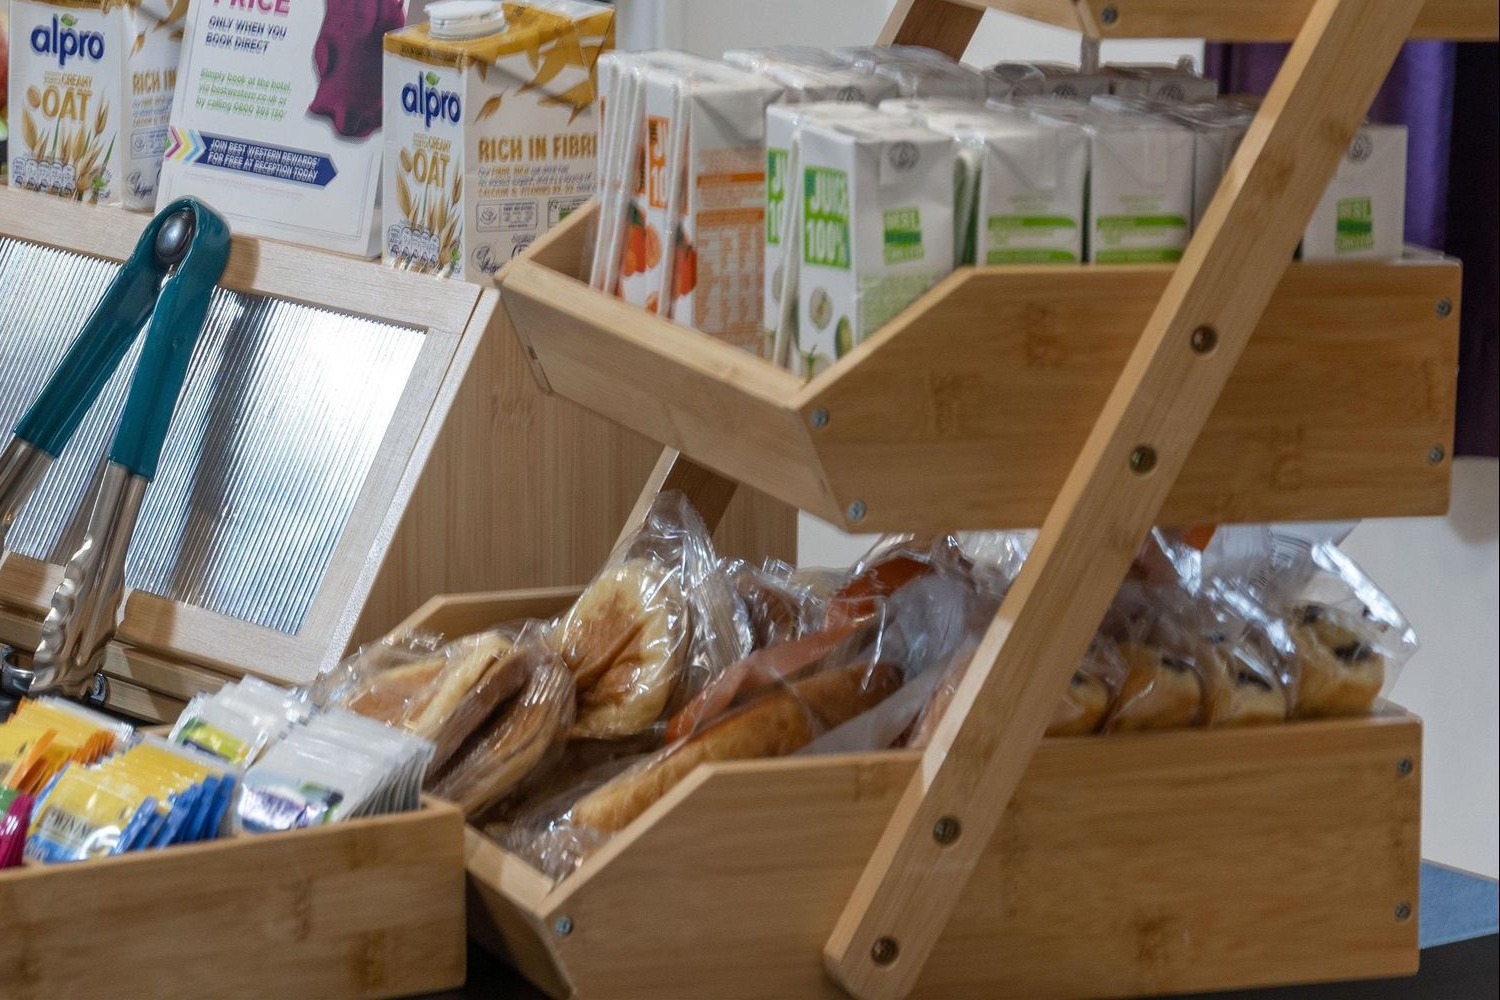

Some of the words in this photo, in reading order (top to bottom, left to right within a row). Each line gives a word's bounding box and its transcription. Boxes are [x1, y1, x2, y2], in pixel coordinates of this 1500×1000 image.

[30, 14, 106, 68] alpro
[208, 16, 234, 30] ONLY
[236, 19, 265, 35] WHEN
[267, 24, 288, 39] YOU
[205, 32, 233, 48] BOOK
[234, 36, 270, 53] DIRECT
[132, 70, 160, 95] RICH
[42, 86, 93, 121] OAT
[402, 71, 462, 130] alpro
[211, 139, 228, 151] JOIN
[228, 142, 247, 154] BEST
[248, 145, 282, 161] WESTERN
[478, 135, 523, 162] RICH
[529, 134, 547, 159] IN
[208, 151, 225, 163] FOR
[225, 154, 244, 166] FREE
[244, 159, 254, 169] AT
[254, 160, 293, 176] RECEPTION
[293, 168, 319, 181] TODAY
[413, 149, 451, 188] OAT
